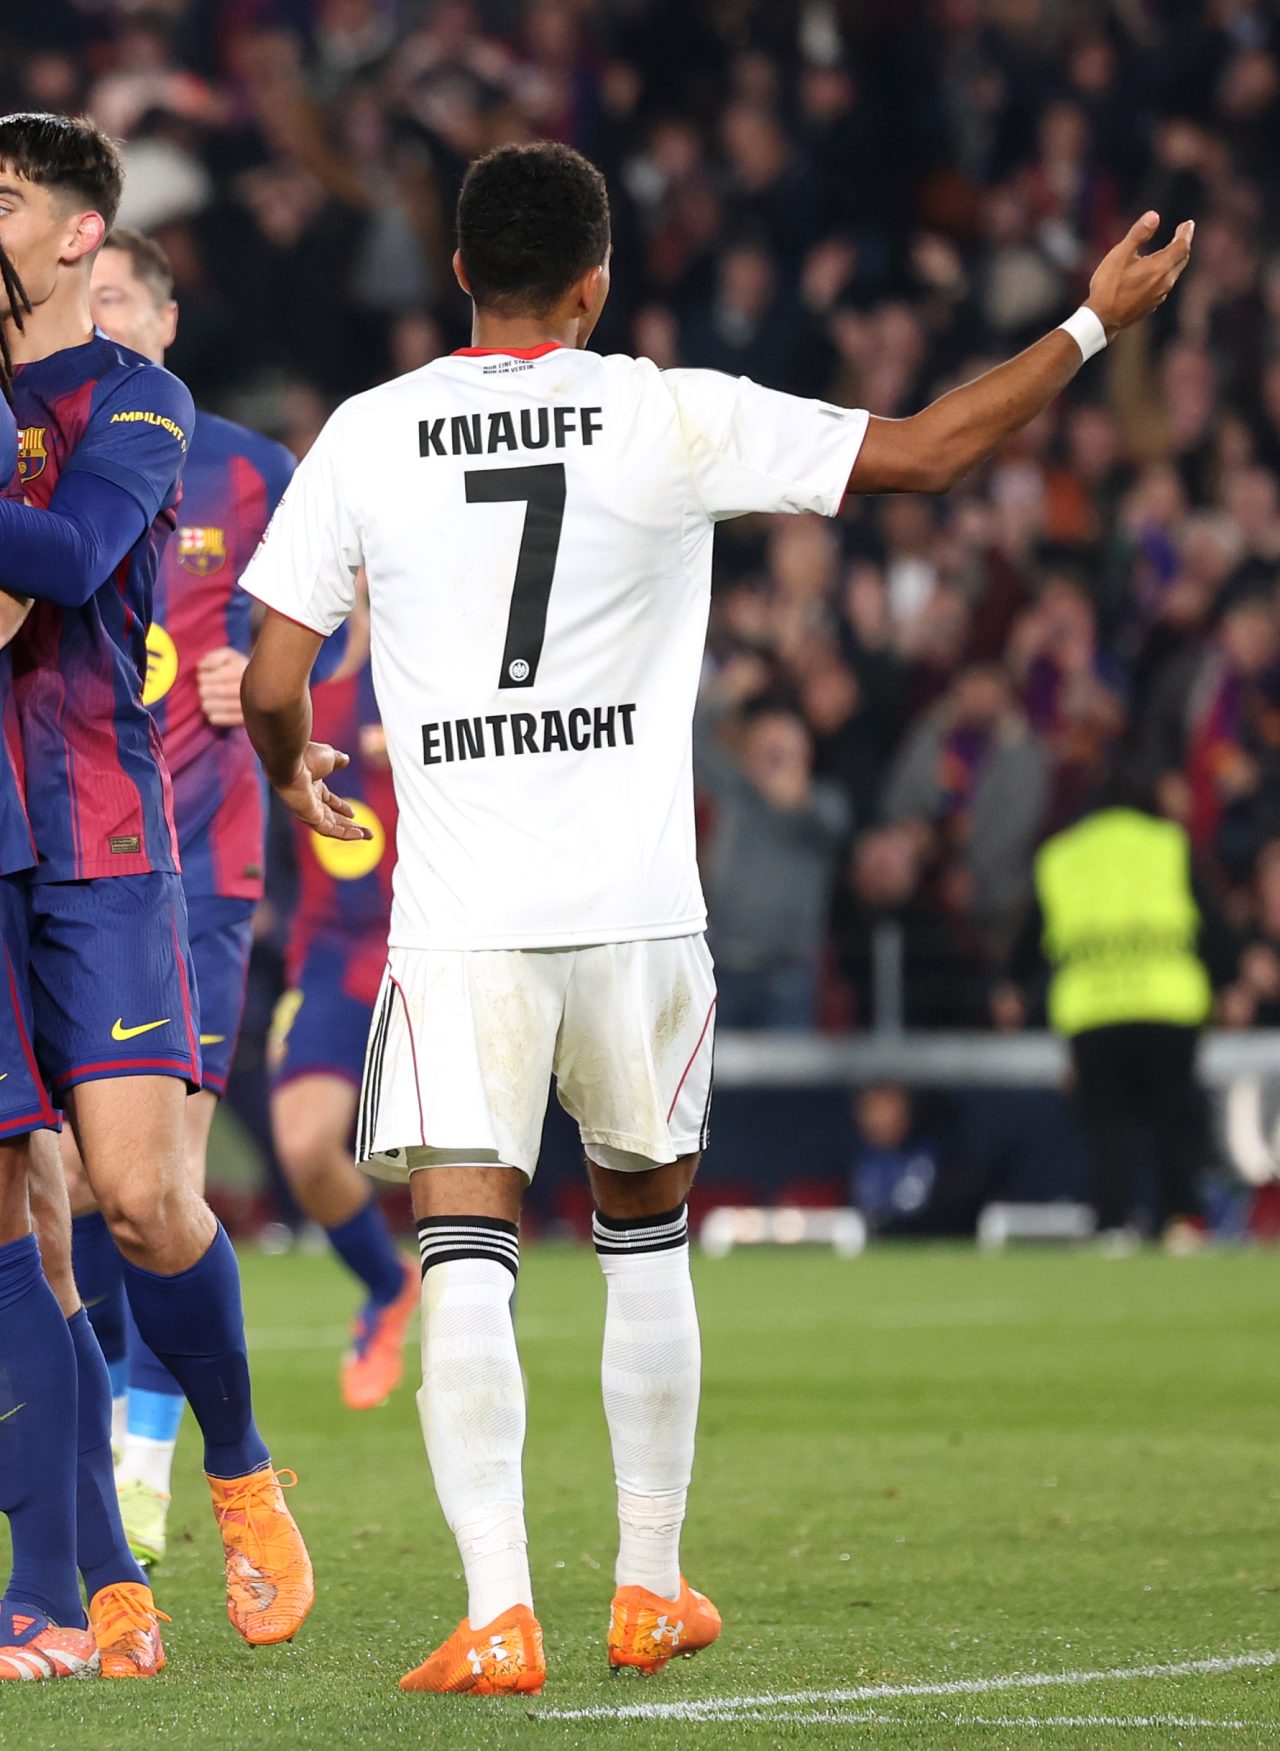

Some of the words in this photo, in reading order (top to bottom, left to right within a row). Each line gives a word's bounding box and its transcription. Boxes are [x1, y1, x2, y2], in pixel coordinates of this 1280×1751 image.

[110, 411, 184, 441] AMBILIGHT
[418, 406, 604, 458] KNAUFF
[463, 462, 567, 690] 7
[421, 703, 637, 766] EINTRACHT
